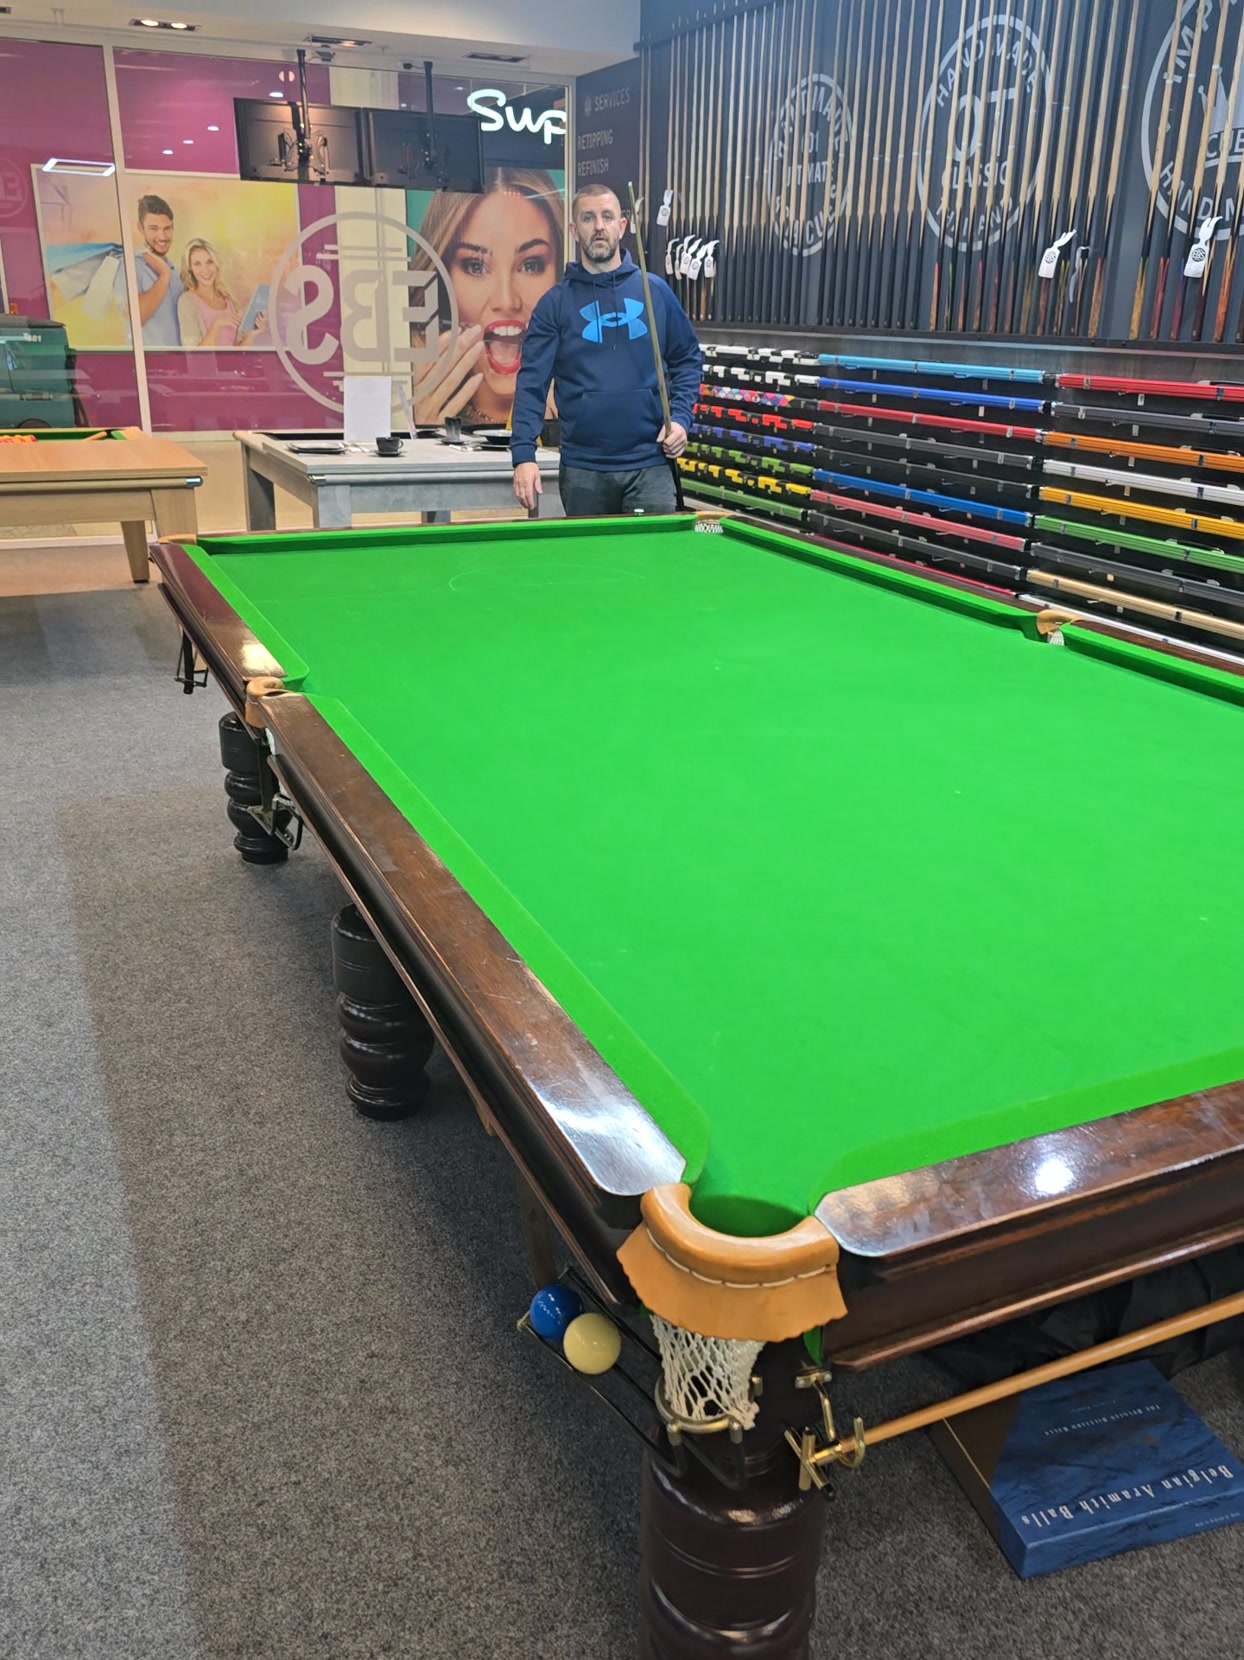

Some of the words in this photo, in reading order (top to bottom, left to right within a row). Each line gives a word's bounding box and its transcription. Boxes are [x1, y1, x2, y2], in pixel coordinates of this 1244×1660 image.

[594, 87, 631, 112] SERVICES
[577, 129, 614, 150] RETIPPING
[577, 158, 609, 177] REFINISH
[1161, 1464, 1234, 1490] Belgian
[1079, 1484, 1155, 1515] Aramith
[1021, 1505, 1074, 1528] Balls
